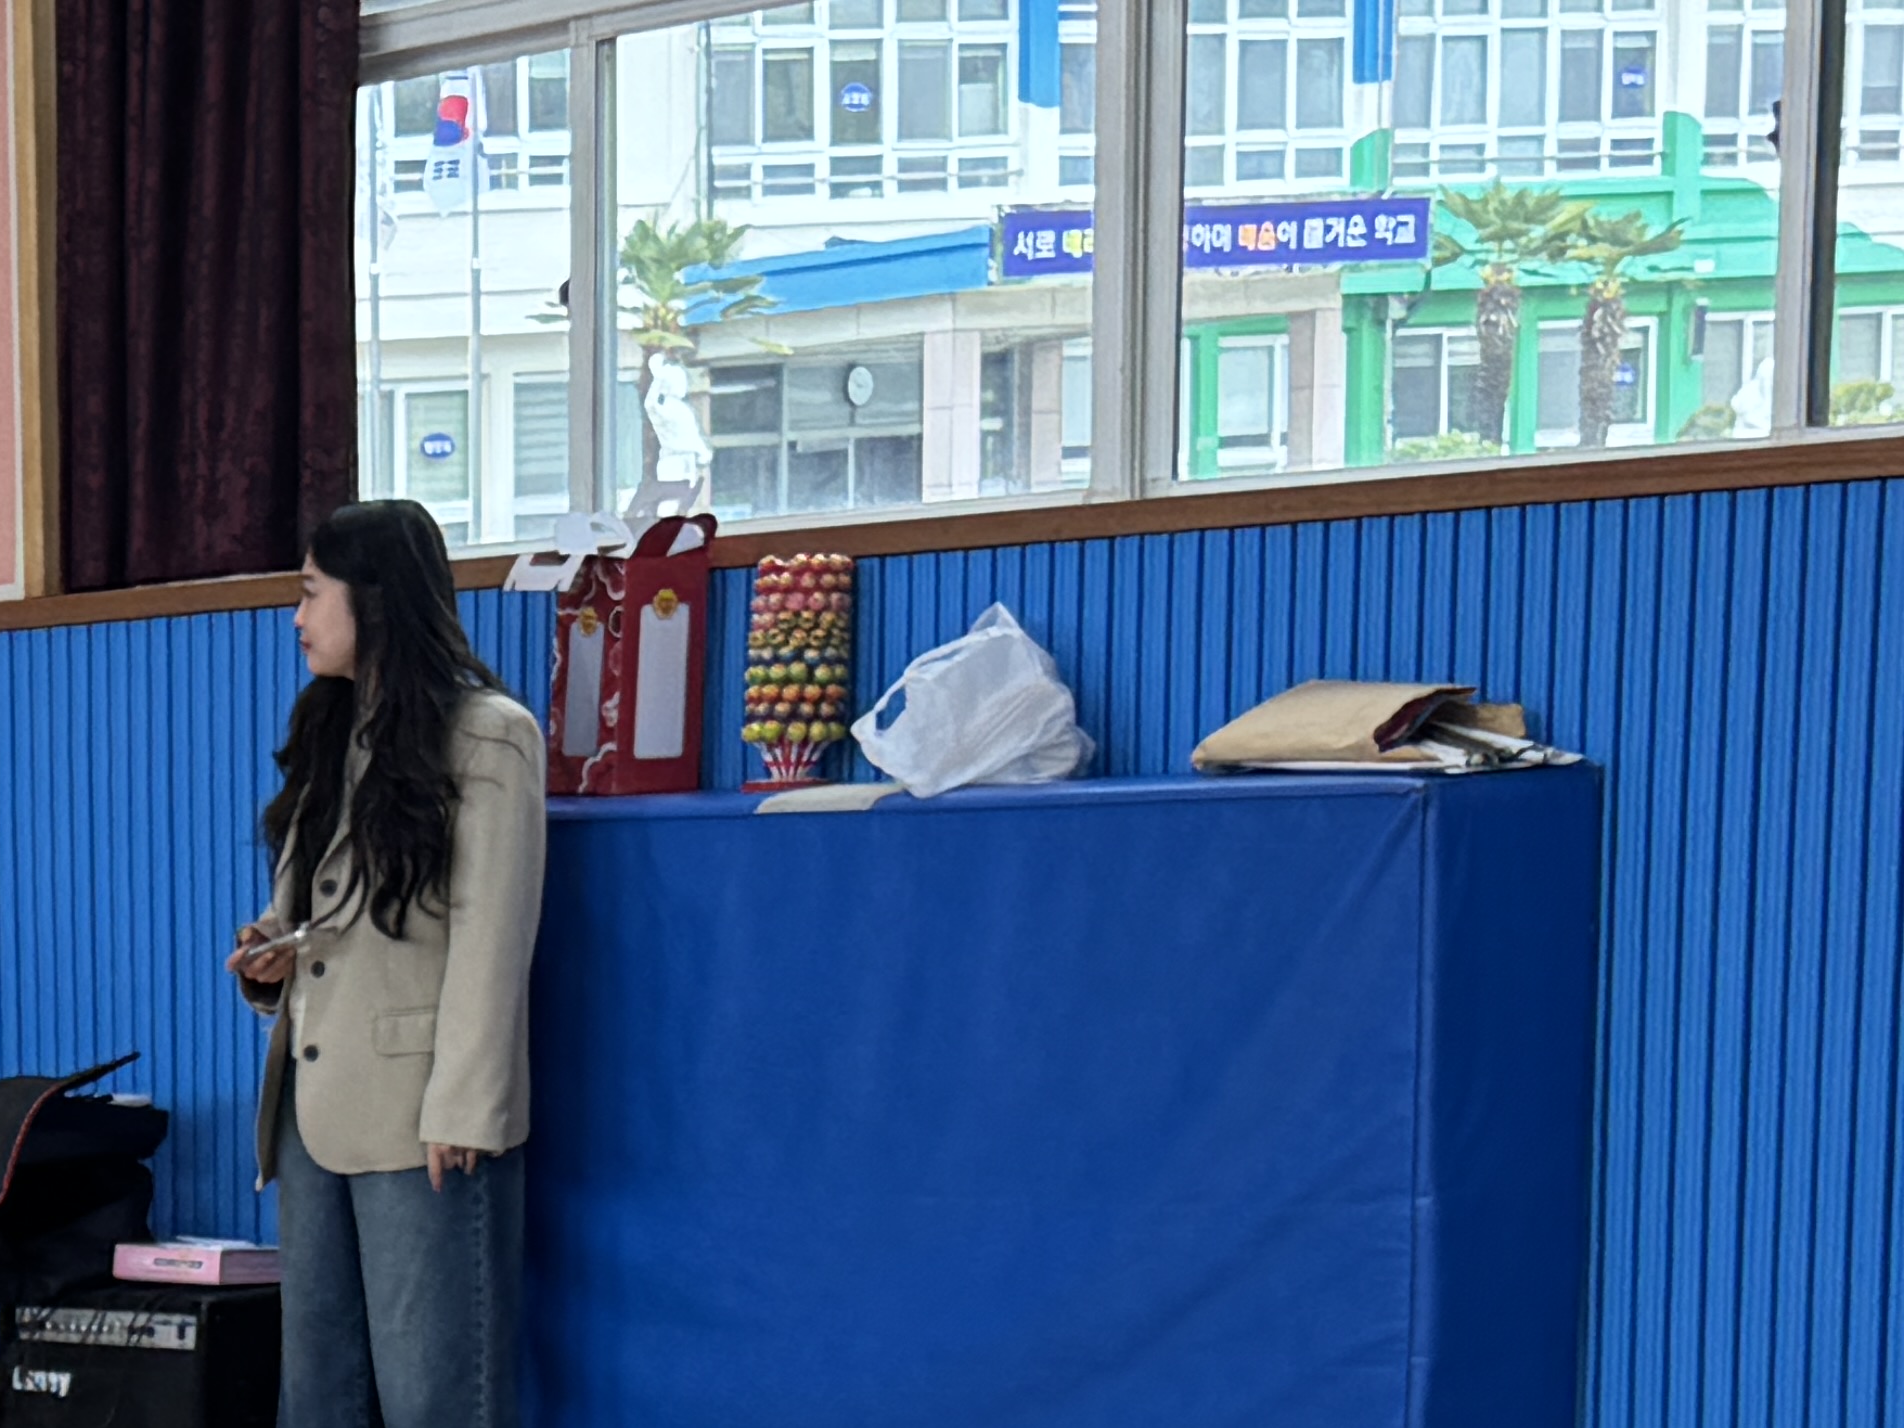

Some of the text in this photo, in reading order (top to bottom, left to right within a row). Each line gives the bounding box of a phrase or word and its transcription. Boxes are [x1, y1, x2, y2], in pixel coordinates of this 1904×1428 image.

[1013, 230, 1056, 260] 서로
[1238, 219, 1298, 252] 배움이
[1303, 213, 1368, 249] 즐거운
[1374, 211, 1416, 246] 학교
